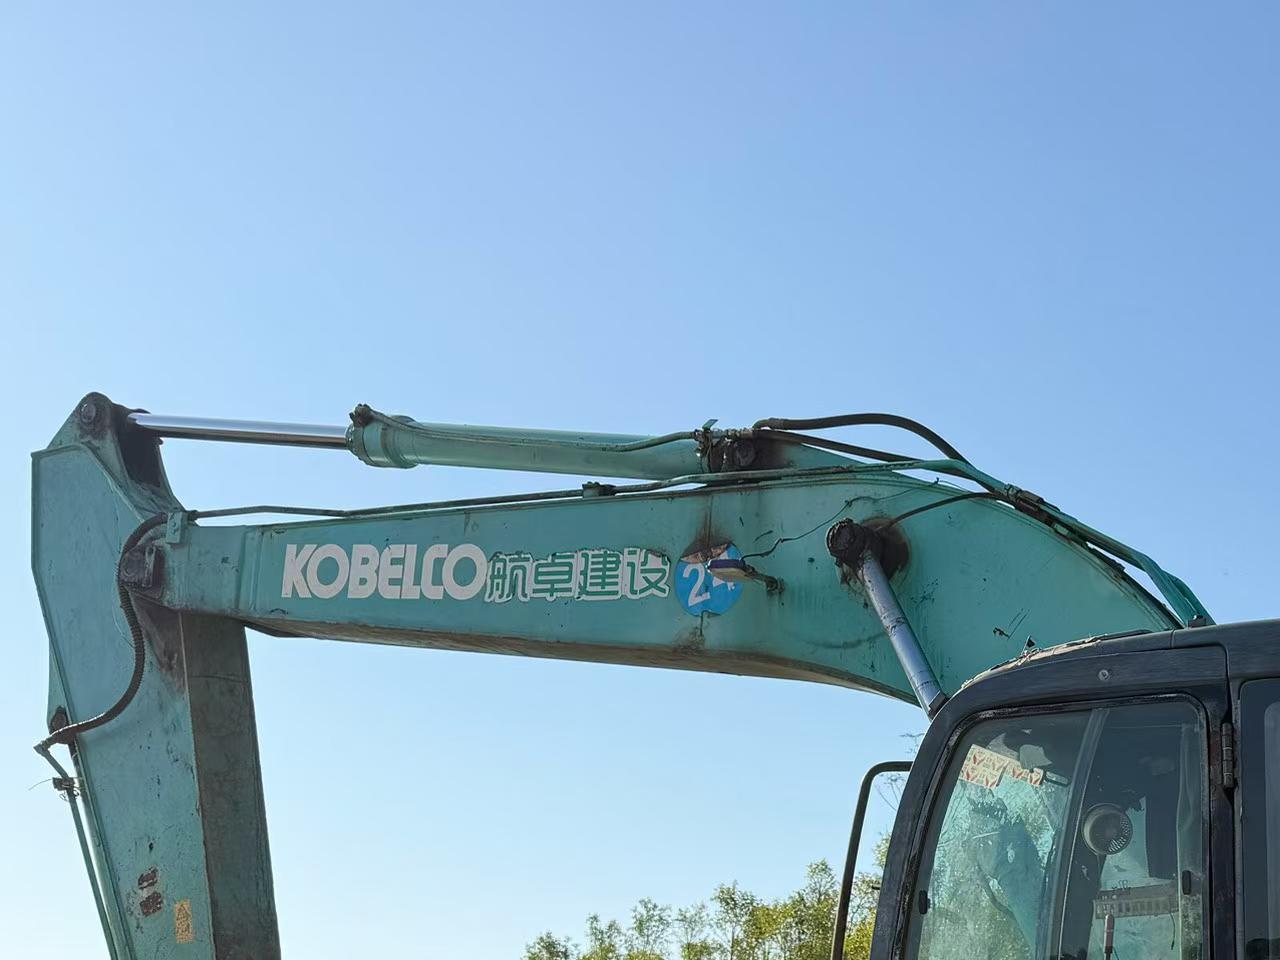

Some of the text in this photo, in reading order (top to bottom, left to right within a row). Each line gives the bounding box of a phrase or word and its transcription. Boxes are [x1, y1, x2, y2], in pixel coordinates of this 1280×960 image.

[282, 543, 671, 602] KOBELCO 航卓建设
